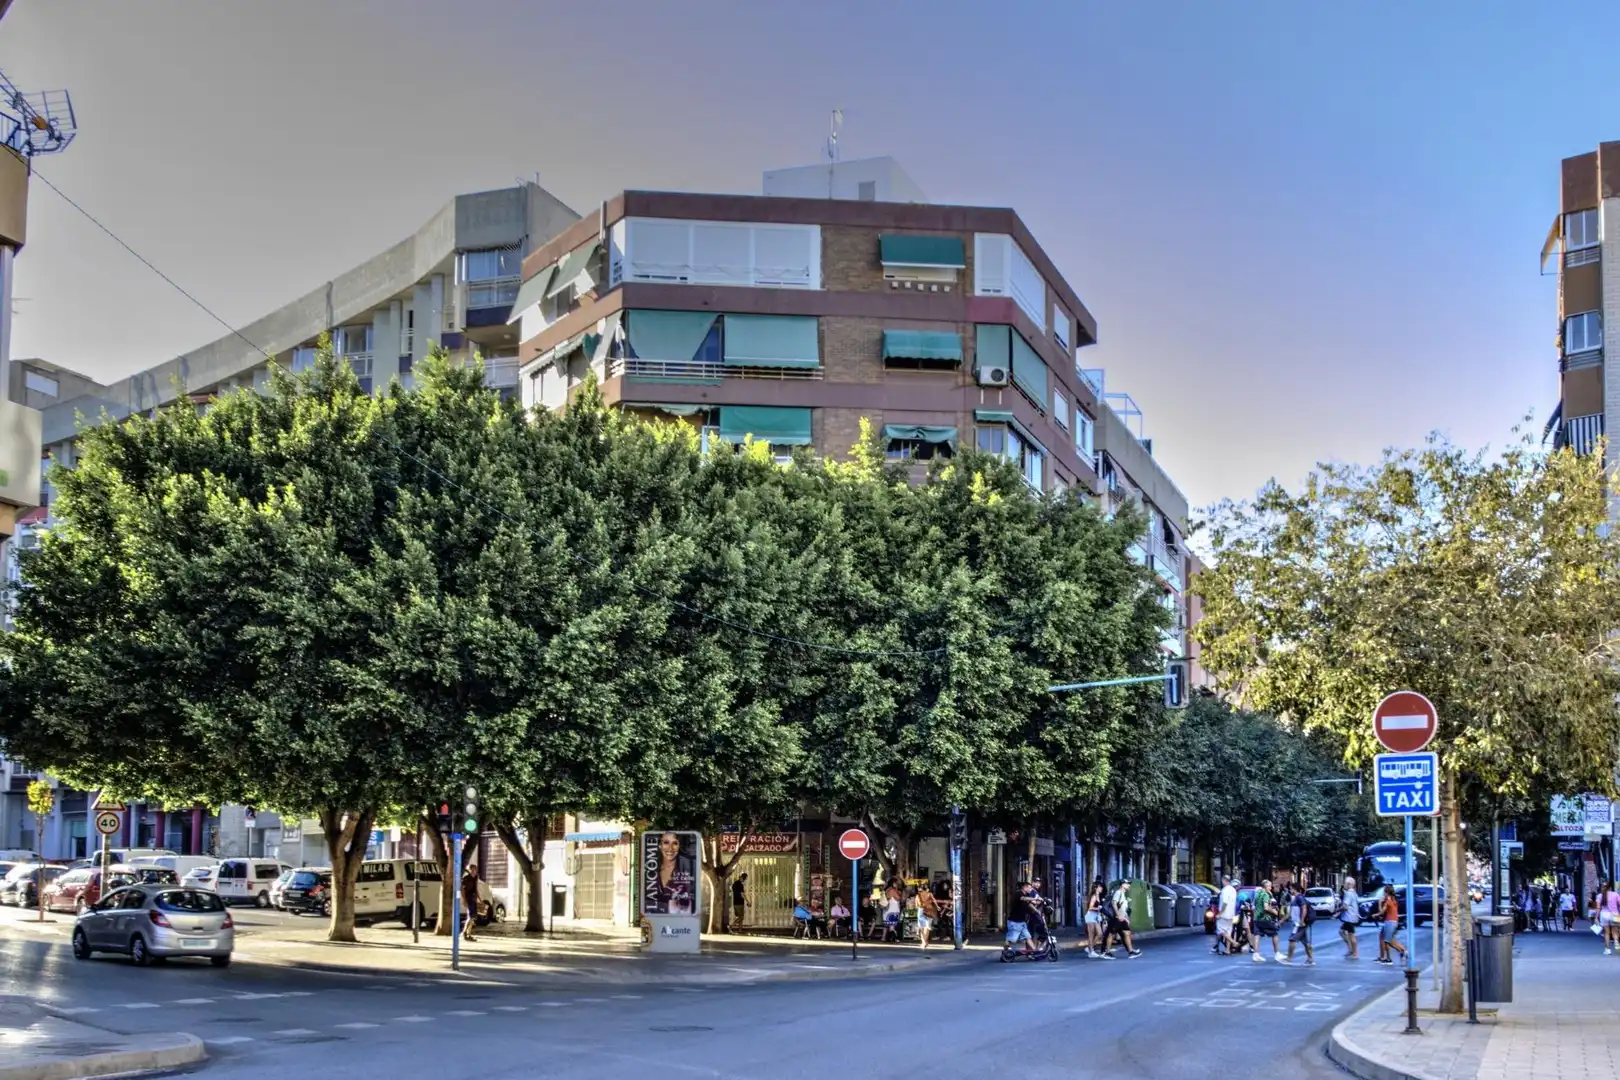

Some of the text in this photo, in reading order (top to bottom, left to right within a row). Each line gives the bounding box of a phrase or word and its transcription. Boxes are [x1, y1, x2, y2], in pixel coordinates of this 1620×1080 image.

[1383, 792, 1430, 809] TAXI
[101, 819, 116, 827] 40
[723, 833, 789, 843] RERACIÓN
[645, 837, 659, 910] LANCÔME
[1153, 997, 1343, 1012] SOLO
